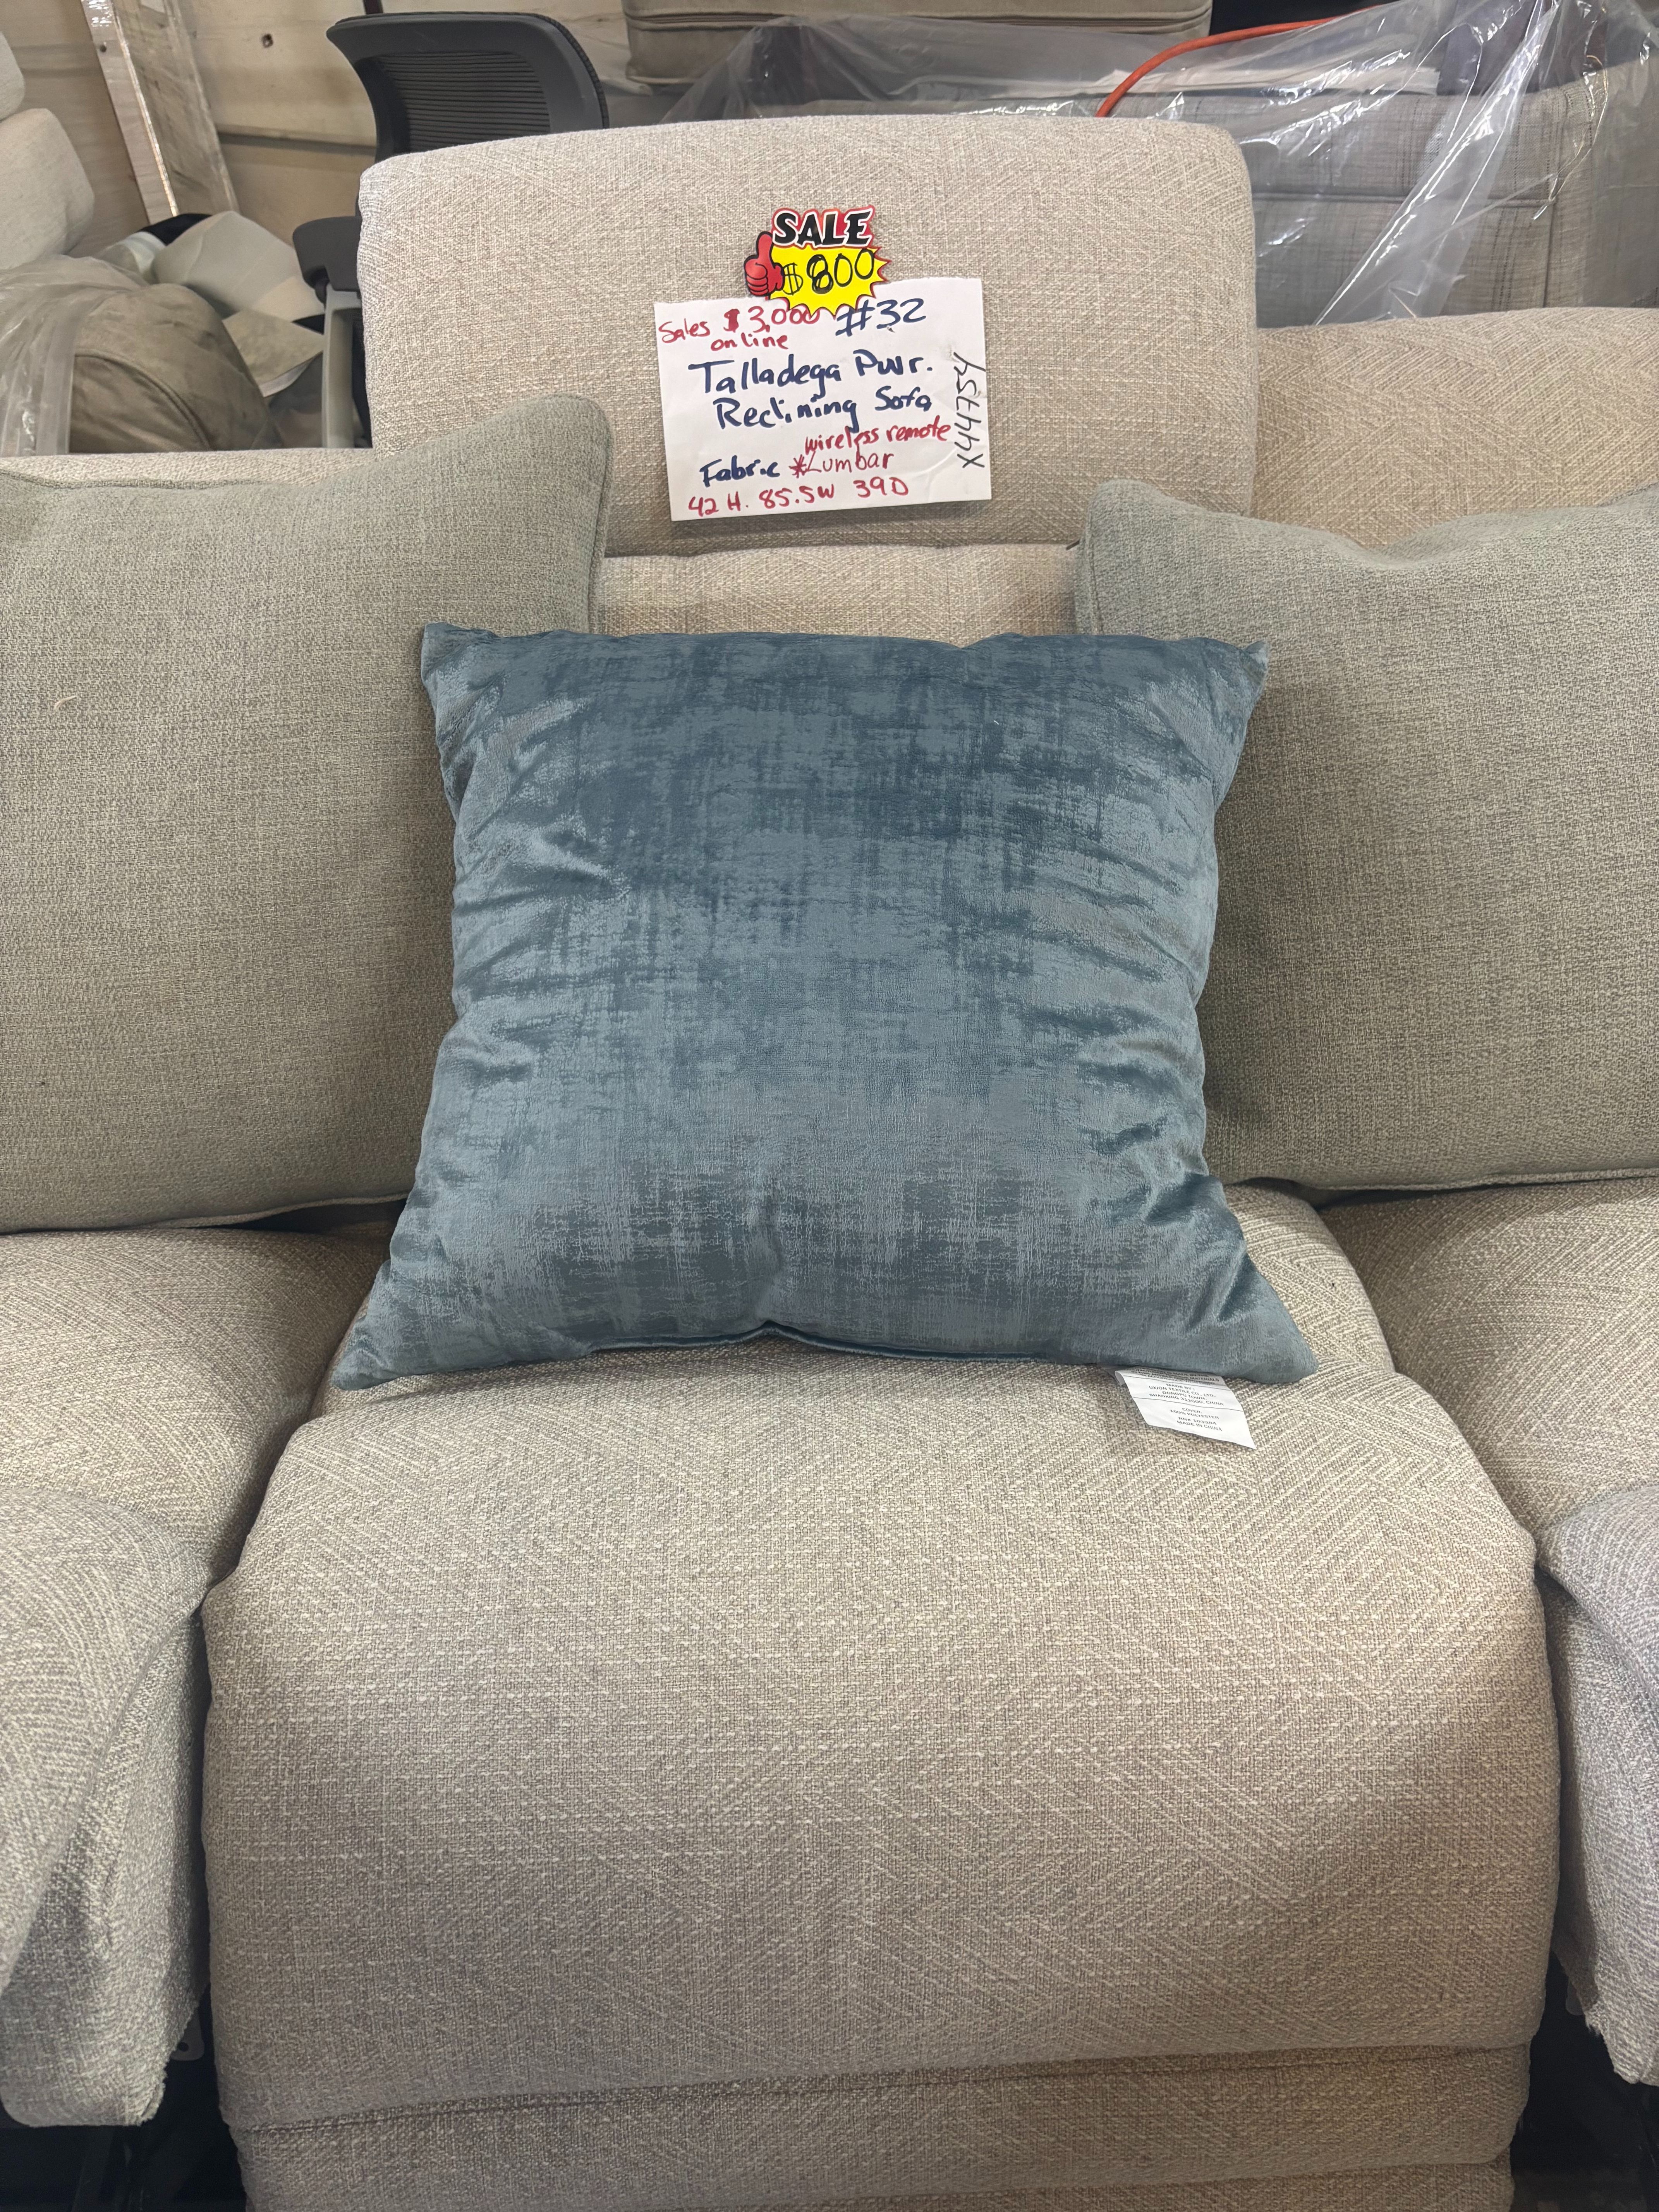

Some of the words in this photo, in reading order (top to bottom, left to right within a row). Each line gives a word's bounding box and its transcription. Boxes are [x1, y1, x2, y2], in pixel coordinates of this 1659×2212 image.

[773, 209, 872, 247] SALE
[782, 248, 874, 295] $800
[658, 318, 710, 343] Sales
[835, 298, 926, 337] #32
[688, 354, 842, 402] Talladega
[713, 397, 859, 433] Reclining
[875, 385, 932, 412] Sofa
[805, 426, 879, 455] wireless
[886, 415, 951, 442] remote
[699, 455, 780, 488] Fabric
